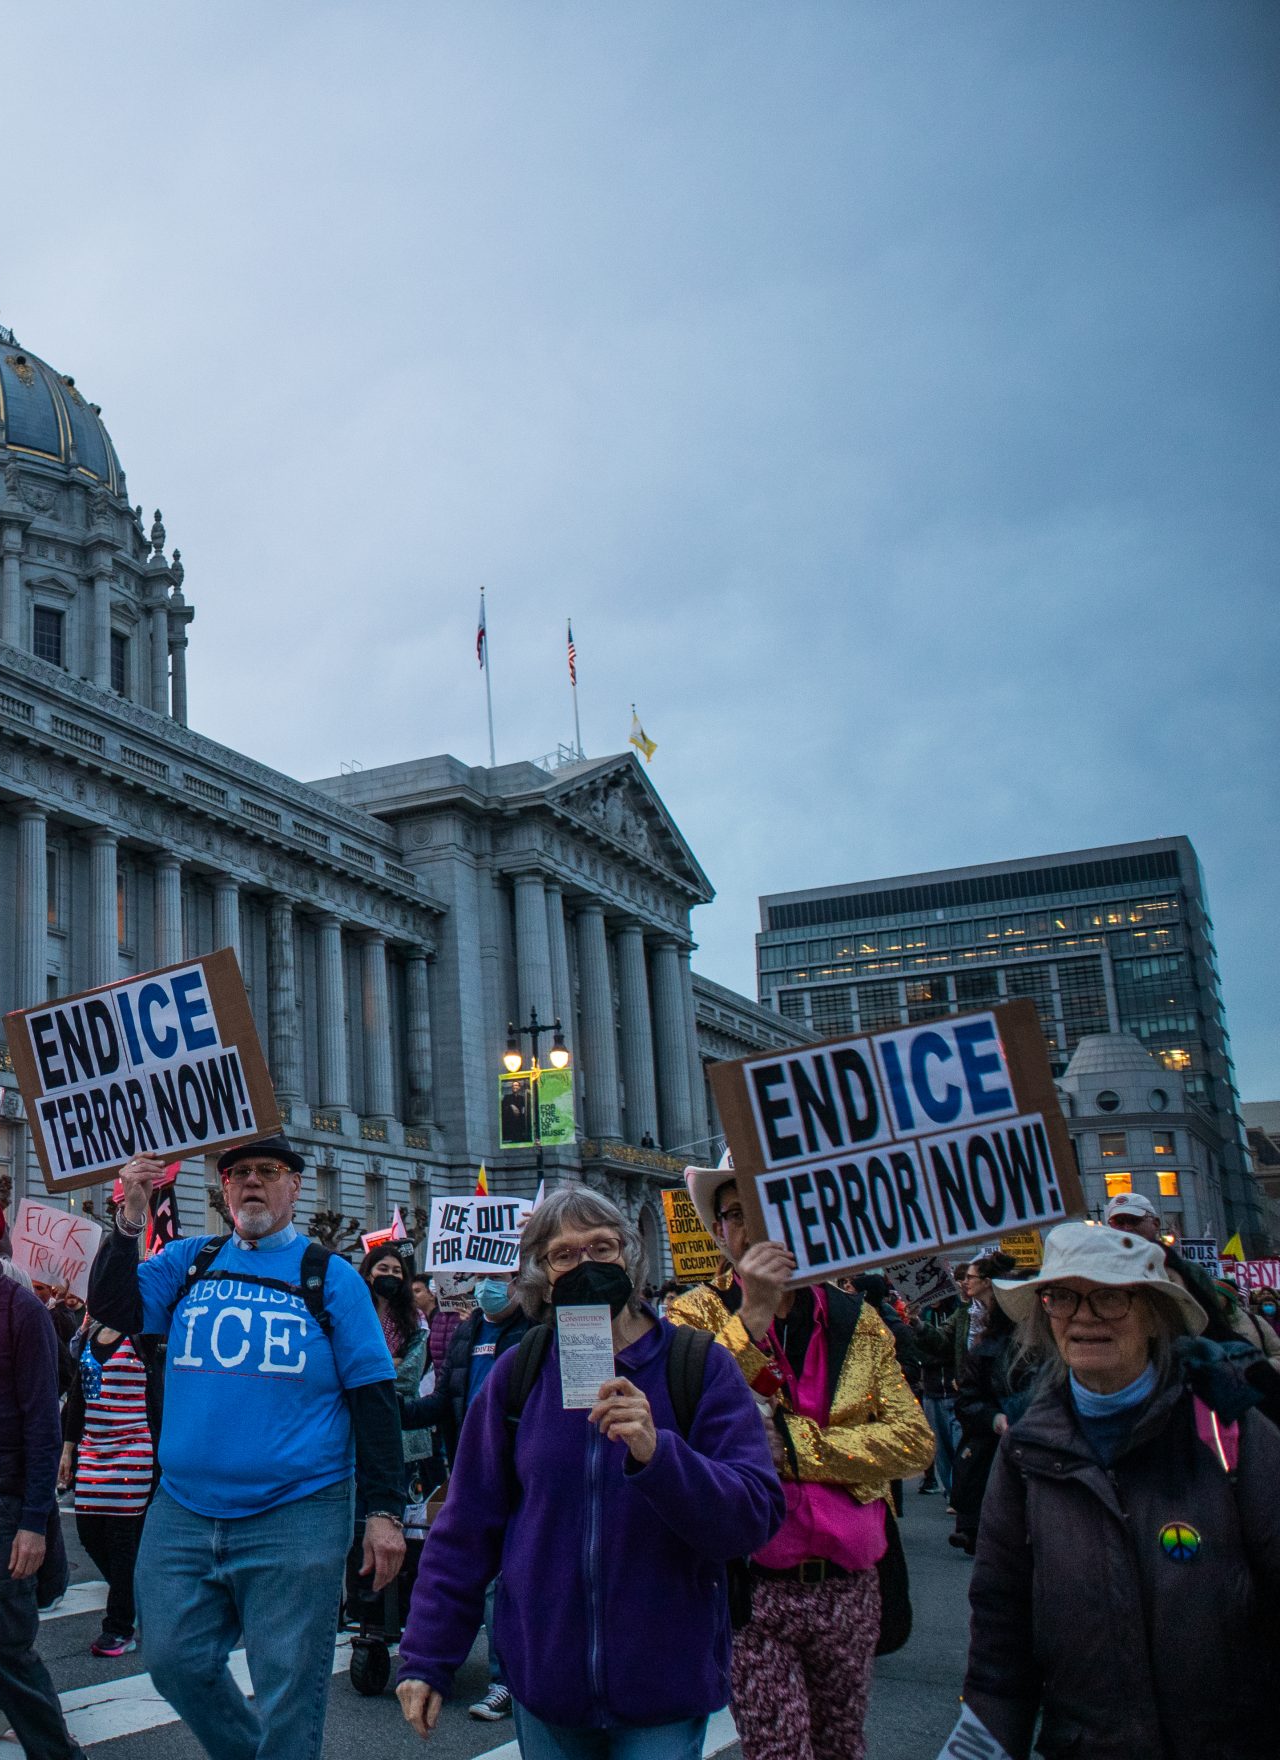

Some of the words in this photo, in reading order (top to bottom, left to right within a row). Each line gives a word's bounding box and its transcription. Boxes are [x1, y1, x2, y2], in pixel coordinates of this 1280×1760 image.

[30, 1000, 120, 1090] END
[117, 971, 217, 1066] ICE
[41, 1078, 159, 1172] TERROR
[150, 1053, 252, 1147] NOW!
[752, 1049, 880, 1161] END
[880, 1021, 1013, 1130] ICE
[673, 1203, 696, 1218] JOBS
[766, 1152, 931, 1270] TERROR
[929, 1122, 1061, 1235] NOW!
[26, 1206, 92, 1255] FUCK
[440, 1203, 470, 1234] ICE
[476, 1203, 520, 1234] OUT
[21, 1238, 88, 1282] TRUMP
[432, 1236, 462, 1266] FOR
[465, 1234, 520, 1266] GOOD!
[672, 1242, 688, 1254] NOT
[688, 1240, 705, 1253] FOR
[1182, 1247, 1195, 1259] NO
[1198, 1247, 1216, 1259] U.S.
[440, 1300, 452, 1308] WE
[173, 1305, 307, 1374] ICE
